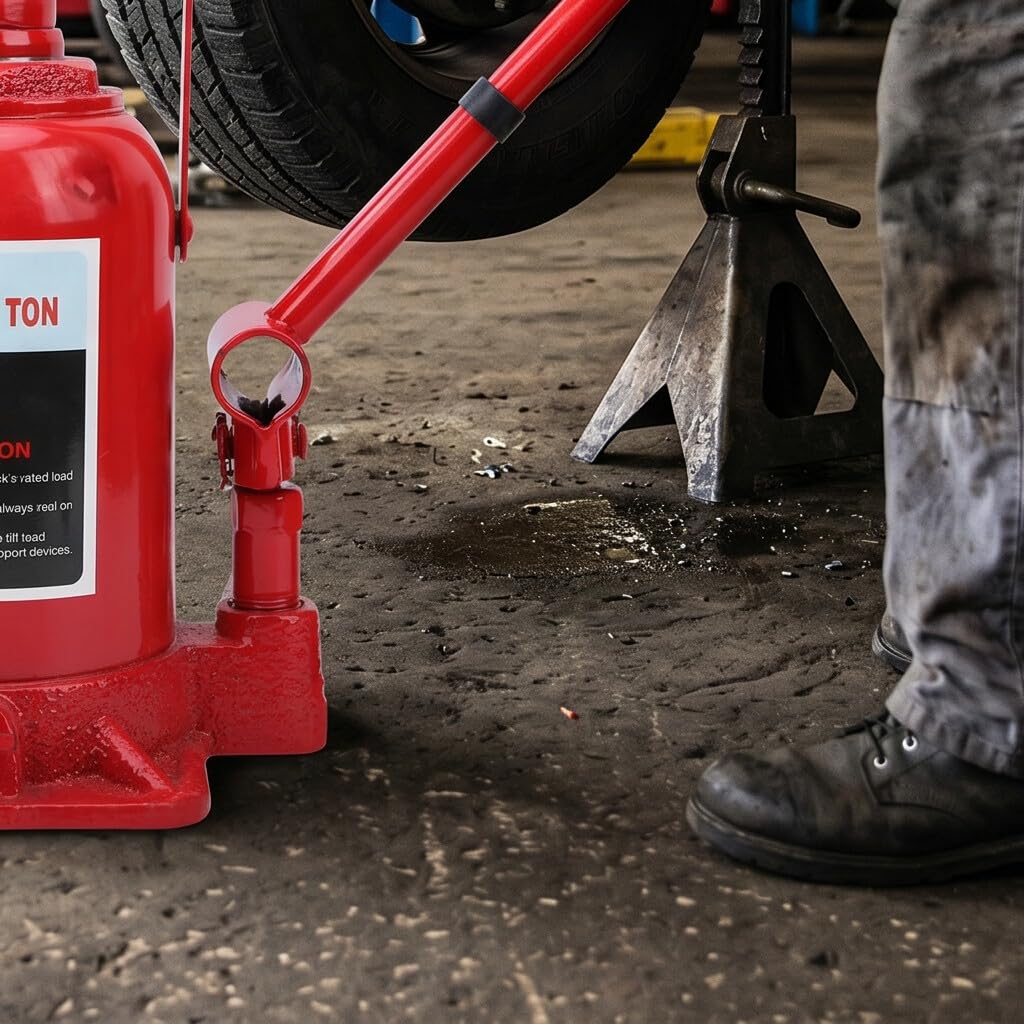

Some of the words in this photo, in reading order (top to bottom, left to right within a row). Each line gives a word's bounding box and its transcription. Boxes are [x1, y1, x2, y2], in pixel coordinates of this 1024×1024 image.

[5, 296, 59, 327] TON
[51, 470, 74, 481] load
[59, 501, 73, 510] on
[29, 545, 73, 557] devices.
